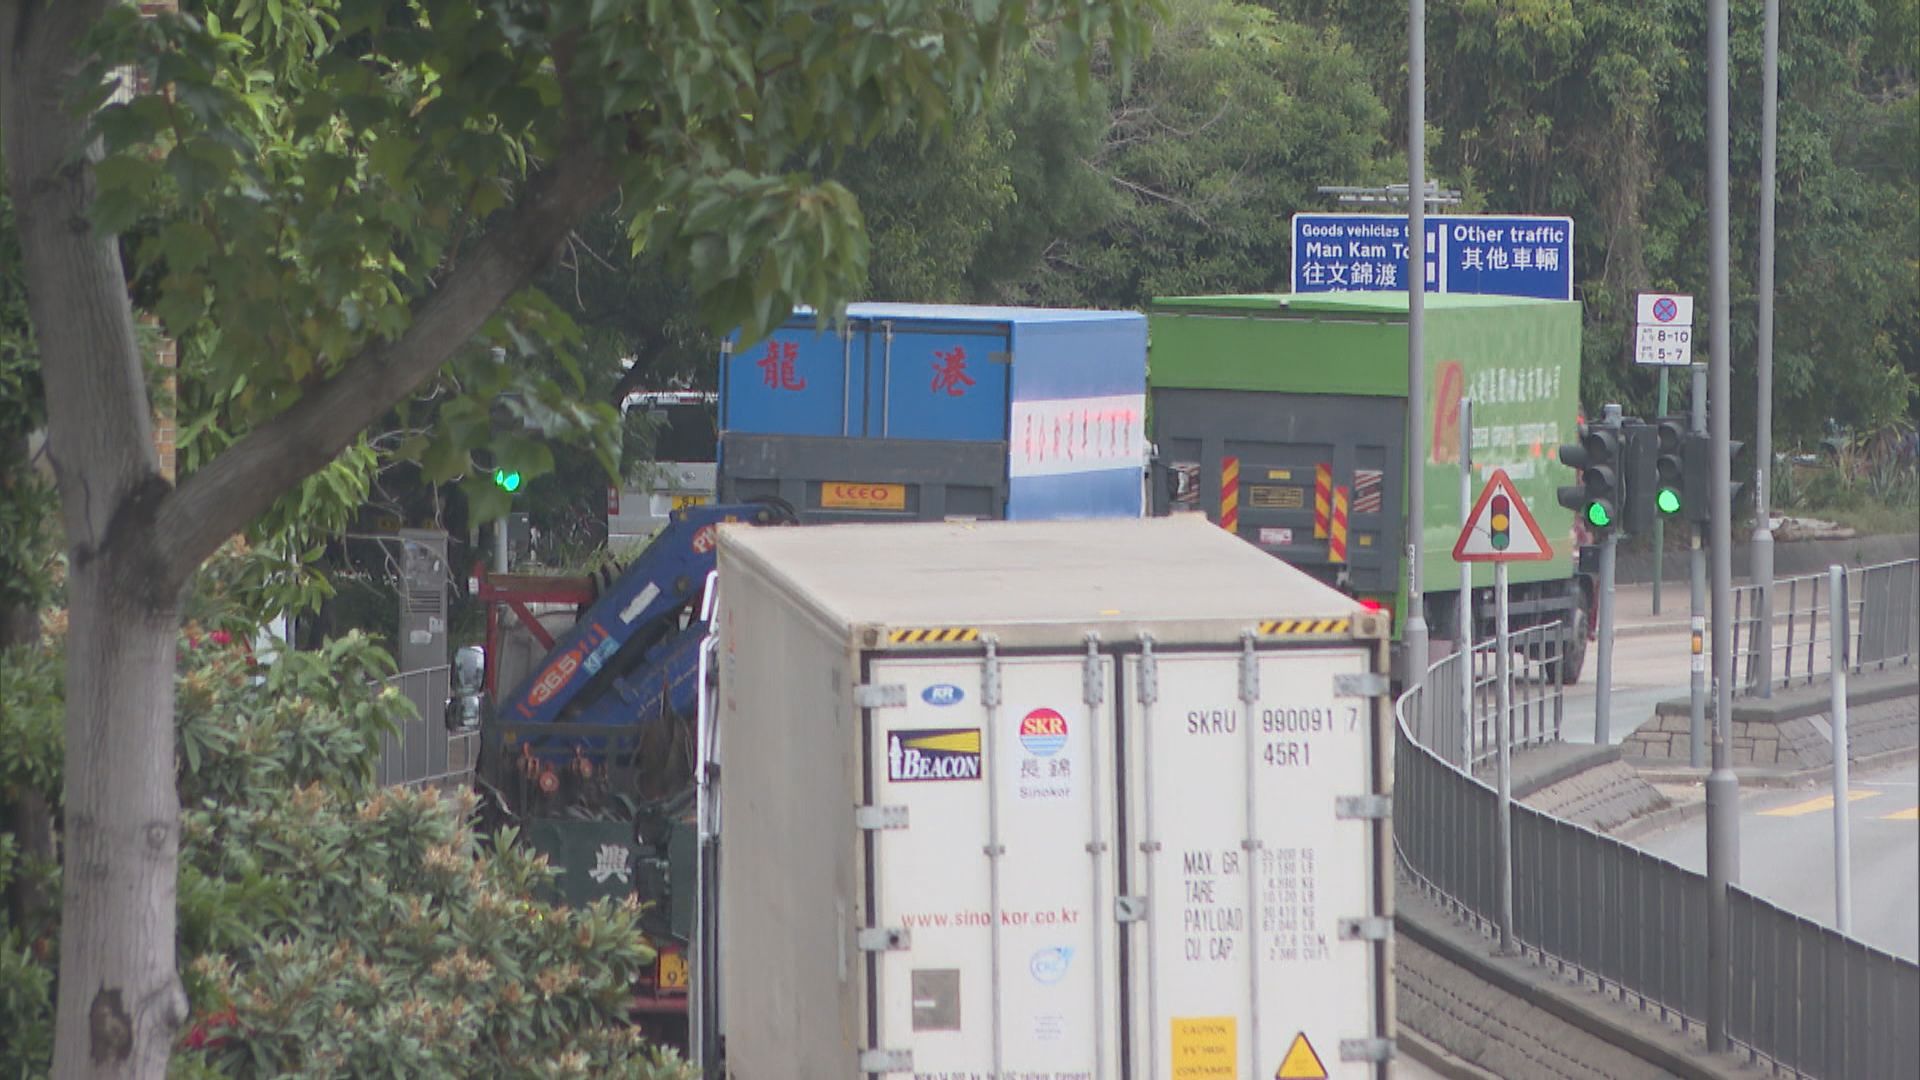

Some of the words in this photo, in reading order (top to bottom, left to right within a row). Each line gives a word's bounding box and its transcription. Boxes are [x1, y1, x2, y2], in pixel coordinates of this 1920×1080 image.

[1302, 224, 1343, 237] Goods
[1347, 224, 1399, 237] vehicles
[1454, 226, 1504, 242] Other
[1510, 227, 1564, 243] traffic
[1306, 242, 1342, 258] Man
[1349, 242, 1386, 258] Kam
[1461, 246, 1559, 271] 其他車輛
[1302, 260, 1398, 287] 往文錦渡
[757, 340, 806, 391] 龍
[931, 345, 976, 396] 港
[1023, 718, 1064, 735] SKR
[1187, 710, 1237, 734] SKRU
[1262, 708, 1333, 732] 990091
[1347, 707, 1357, 731] 7
[904, 749, 980, 778] BEACON
[1264, 742, 1310, 766] 45R1
[1183, 880, 1216, 903] TARE
[1184, 907, 1244, 932] PAYLOAD
